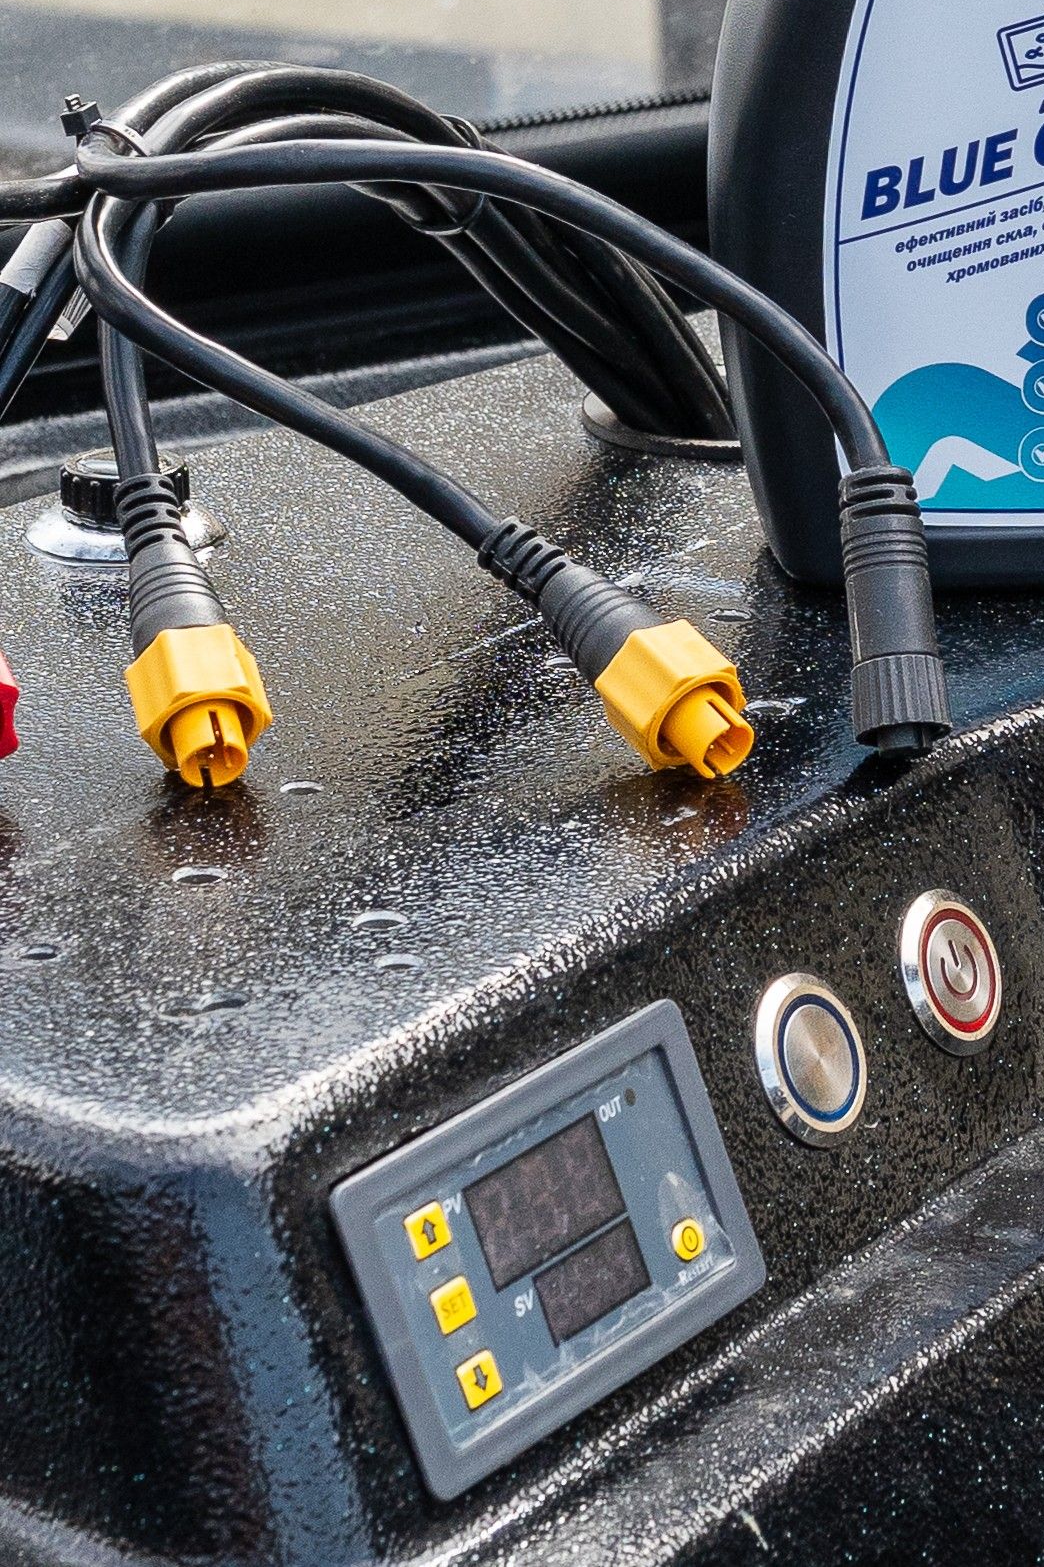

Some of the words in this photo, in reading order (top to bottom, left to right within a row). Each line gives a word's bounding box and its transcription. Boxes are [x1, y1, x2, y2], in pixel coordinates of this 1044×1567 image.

[861, 128, 1018, 221] BLUE
[895, 211, 996, 254] ефективний
[906, 236, 992, 272] очищення
[995, 224, 1038, 247] скла,
[598, 1095, 622, 1123] OUT
[442, 1192, 462, 1221] PV
[440, 1290, 467, 1319] SET
[513, 1288, 535, 1318] SV
